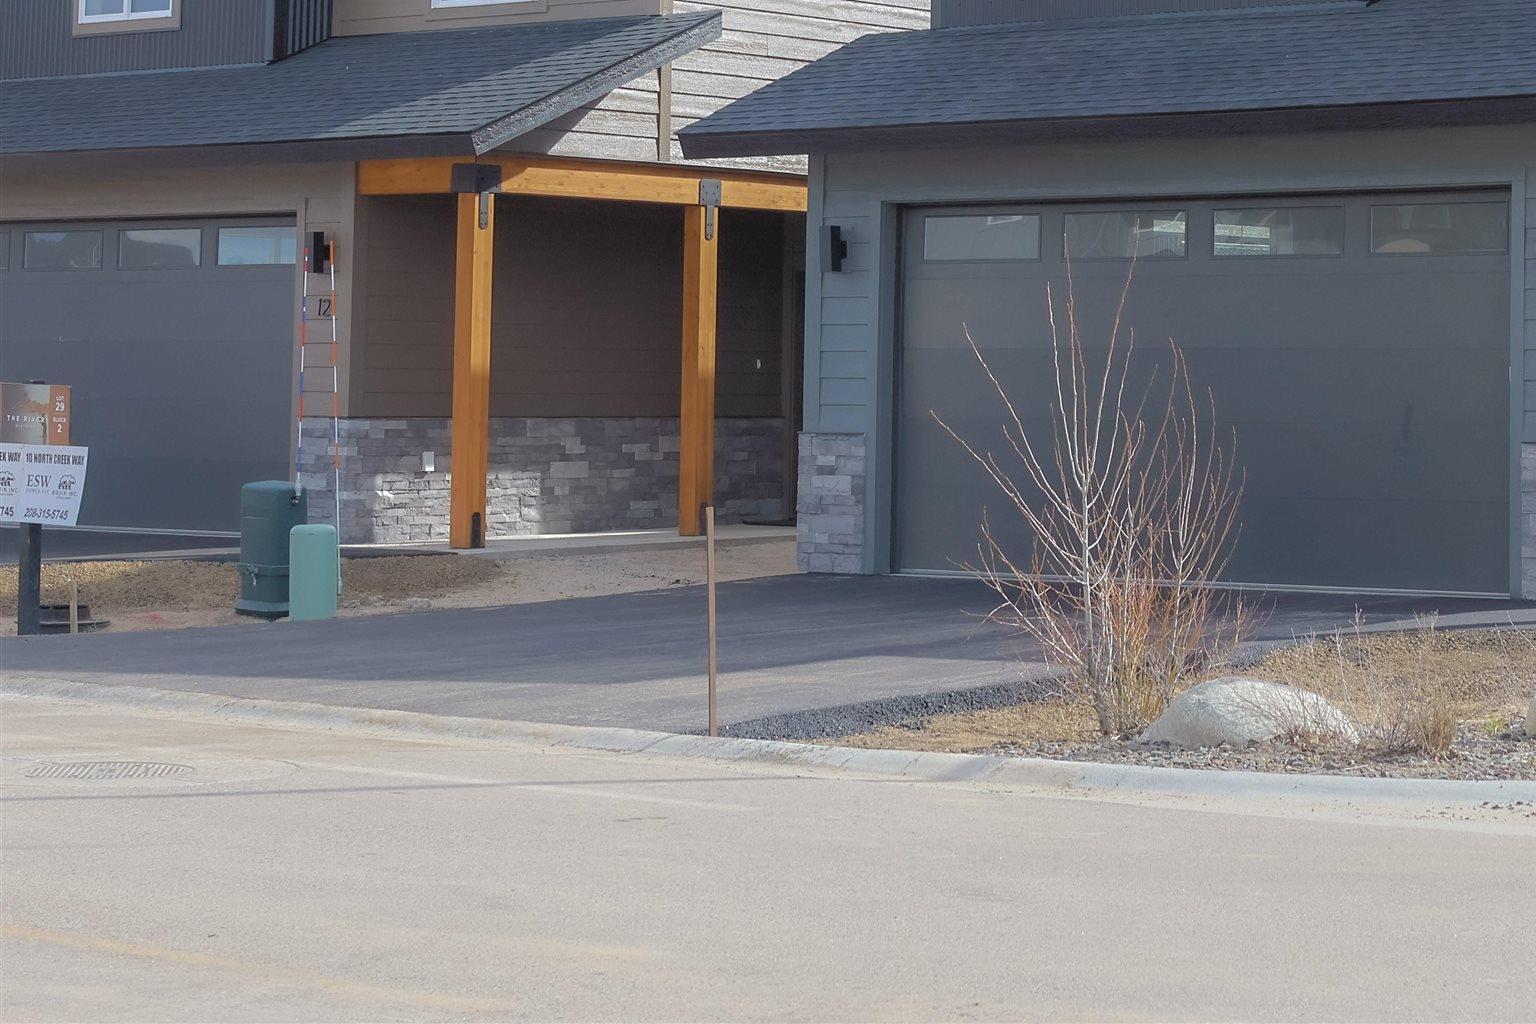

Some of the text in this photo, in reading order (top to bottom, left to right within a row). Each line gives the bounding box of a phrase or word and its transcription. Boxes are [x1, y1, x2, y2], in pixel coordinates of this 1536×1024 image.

[318, 298, 332, 317] 12
[55, 403, 65, 412] 29
[7, 414, 46, 423] THE RIVER
[57, 424, 62, 433] 2
[7, 452, 22, 463] WAY
[25, 452, 85, 466] 10 NORTH CREEK WAY
[27, 474, 52, 488] ESW
[24, 507, 69, 520] 208-315-5745
